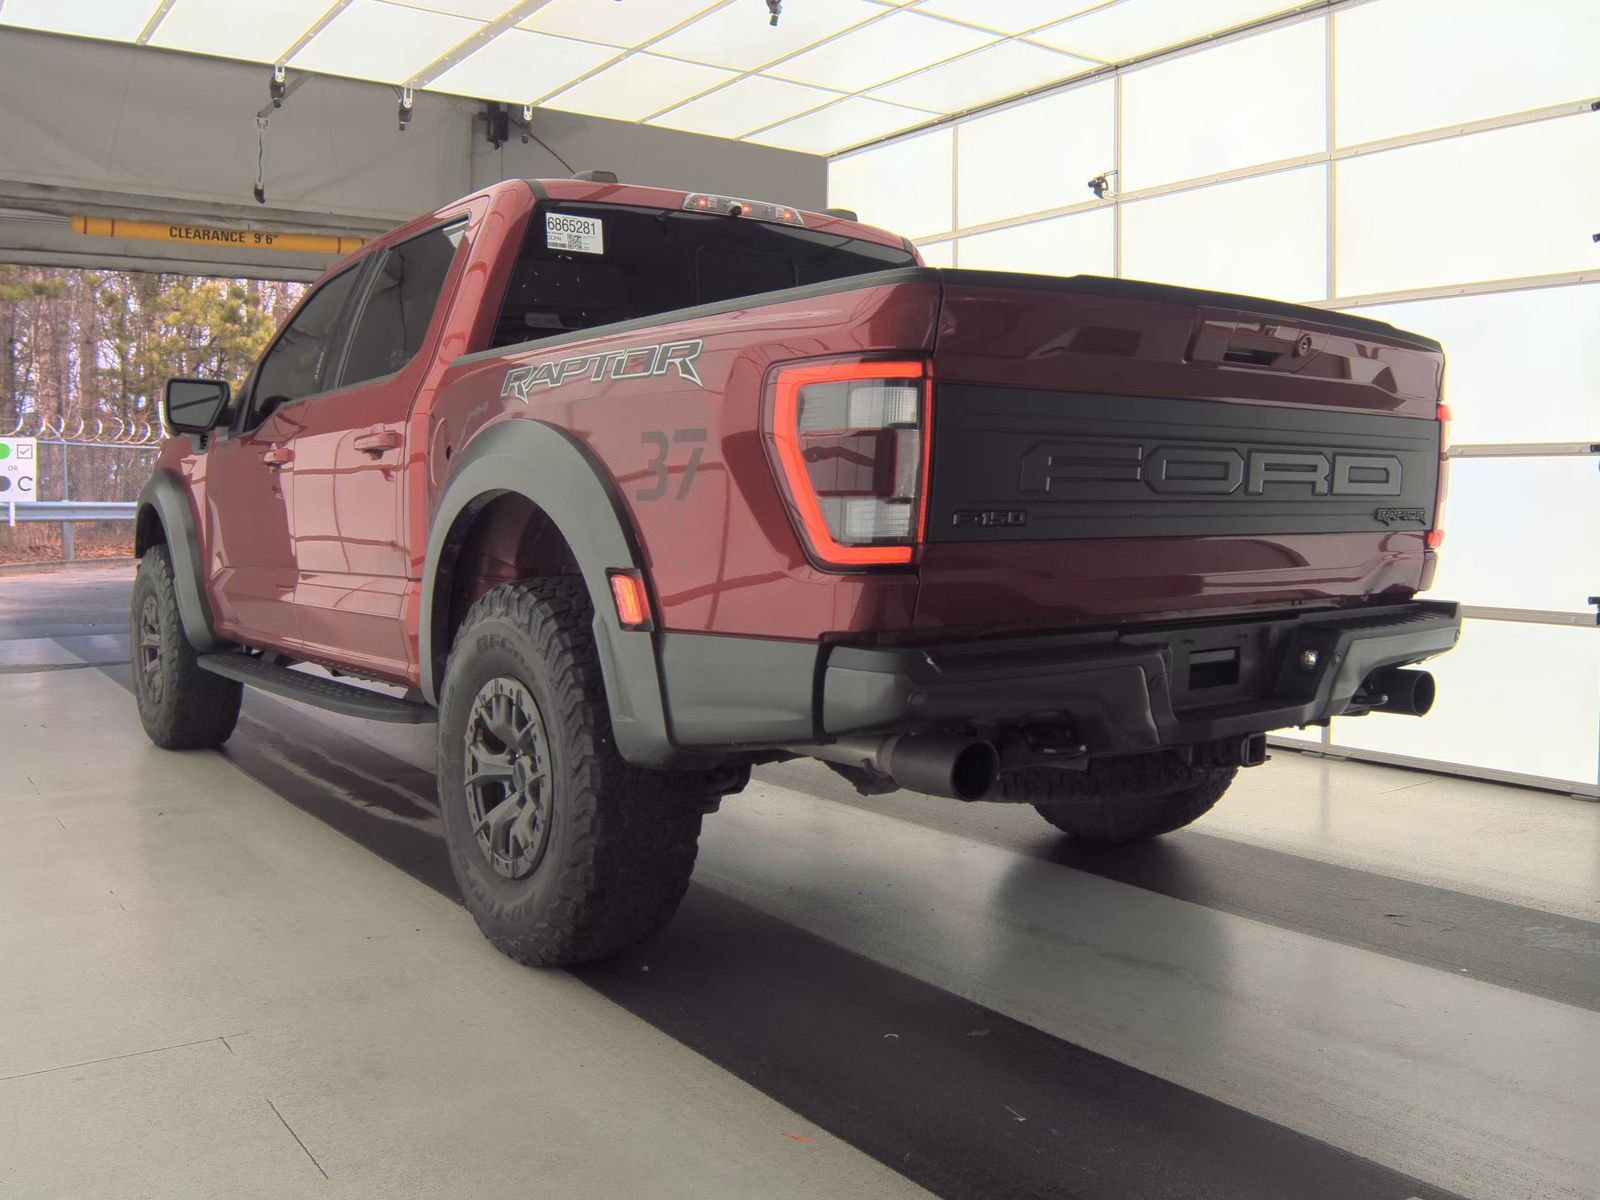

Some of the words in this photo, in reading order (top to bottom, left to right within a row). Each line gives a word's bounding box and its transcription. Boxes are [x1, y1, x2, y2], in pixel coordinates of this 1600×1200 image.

[169, 226, 246, 243] CLEARANCE
[547, 216, 596, 236] 6865281
[500, 338, 703, 404] RAPTOR
[636, 428, 708, 502] 37
[1019, 440, 1404, 497] FORD
[18, 476, 33, 492] C
[951, 509, 1027, 528] F-150
[1375, 507, 1427, 526] RAPTOR
